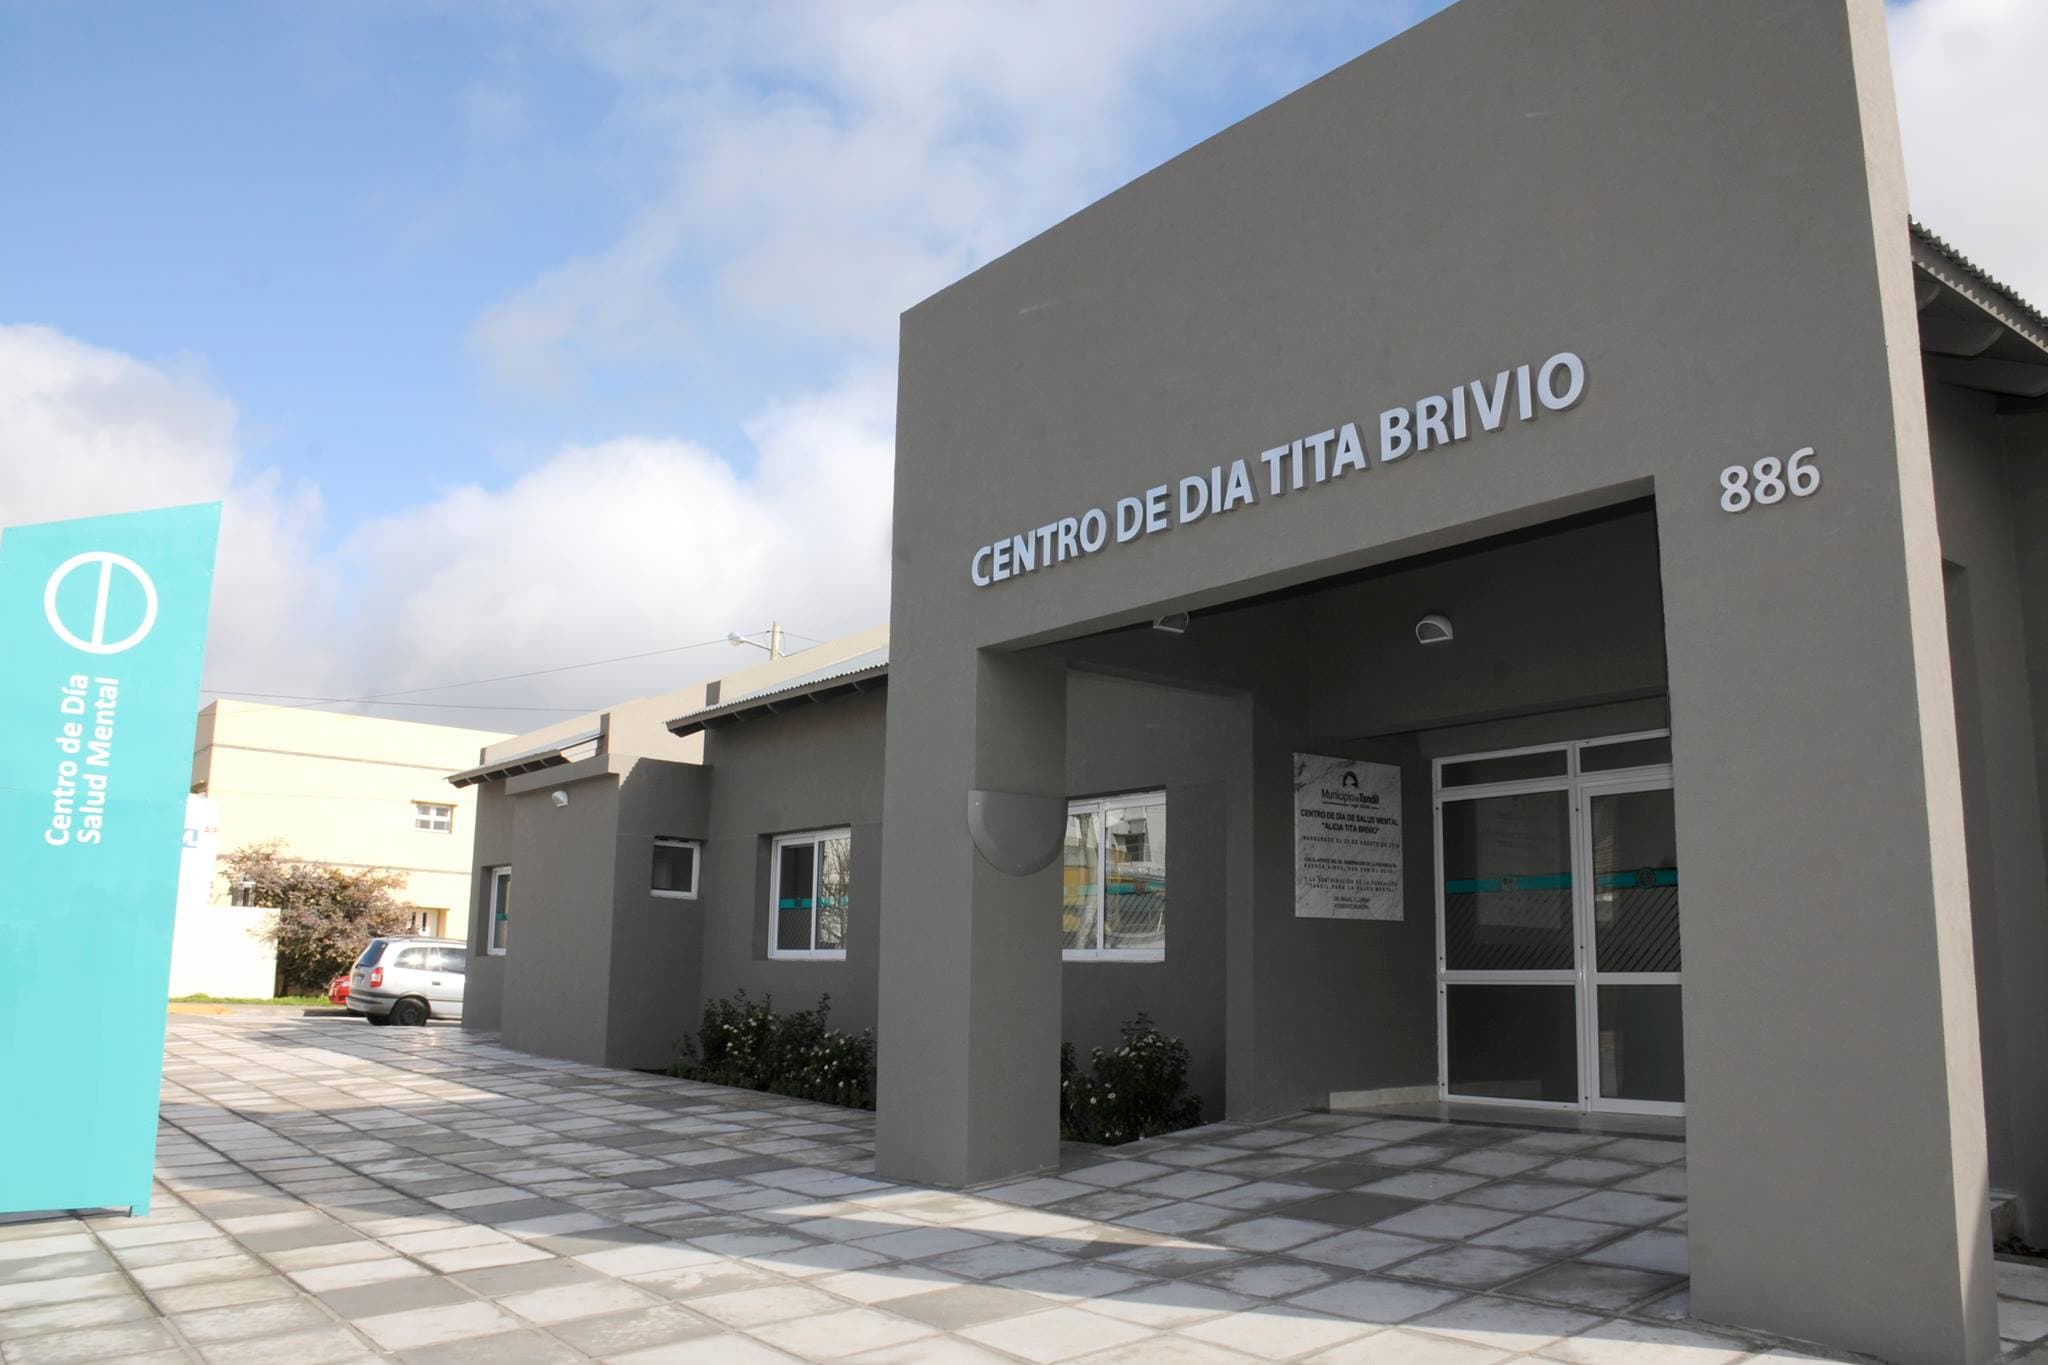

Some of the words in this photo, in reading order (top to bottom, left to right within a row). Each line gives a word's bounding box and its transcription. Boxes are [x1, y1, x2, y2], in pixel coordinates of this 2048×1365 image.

[972, 509, 1107, 587] CENTRO
[1117, 485, 1168, 543] DE
[1179, 459, 1254, 524] DIA
[1261, 423, 1366, 496] TITA
[1379, 352, 1585, 462] BRIVIO
[1719, 446, 1820, 513] 886
[60, 674, 89, 715] Día
[86, 677, 119, 767] Mental
[56, 722, 83, 754] de
[44, 761, 78, 846] Centro
[76, 774, 108, 845] Salud
[1300, 809, 1326, 819] CENTRO
[1326, 811, 1335, 819] DE
[1347, 814, 1356, 822] DE
[1356, 814, 1376, 824] SALUD
[1376, 817, 1399, 826] MENTAL
[1345, 824, 1358, 833] TITA
